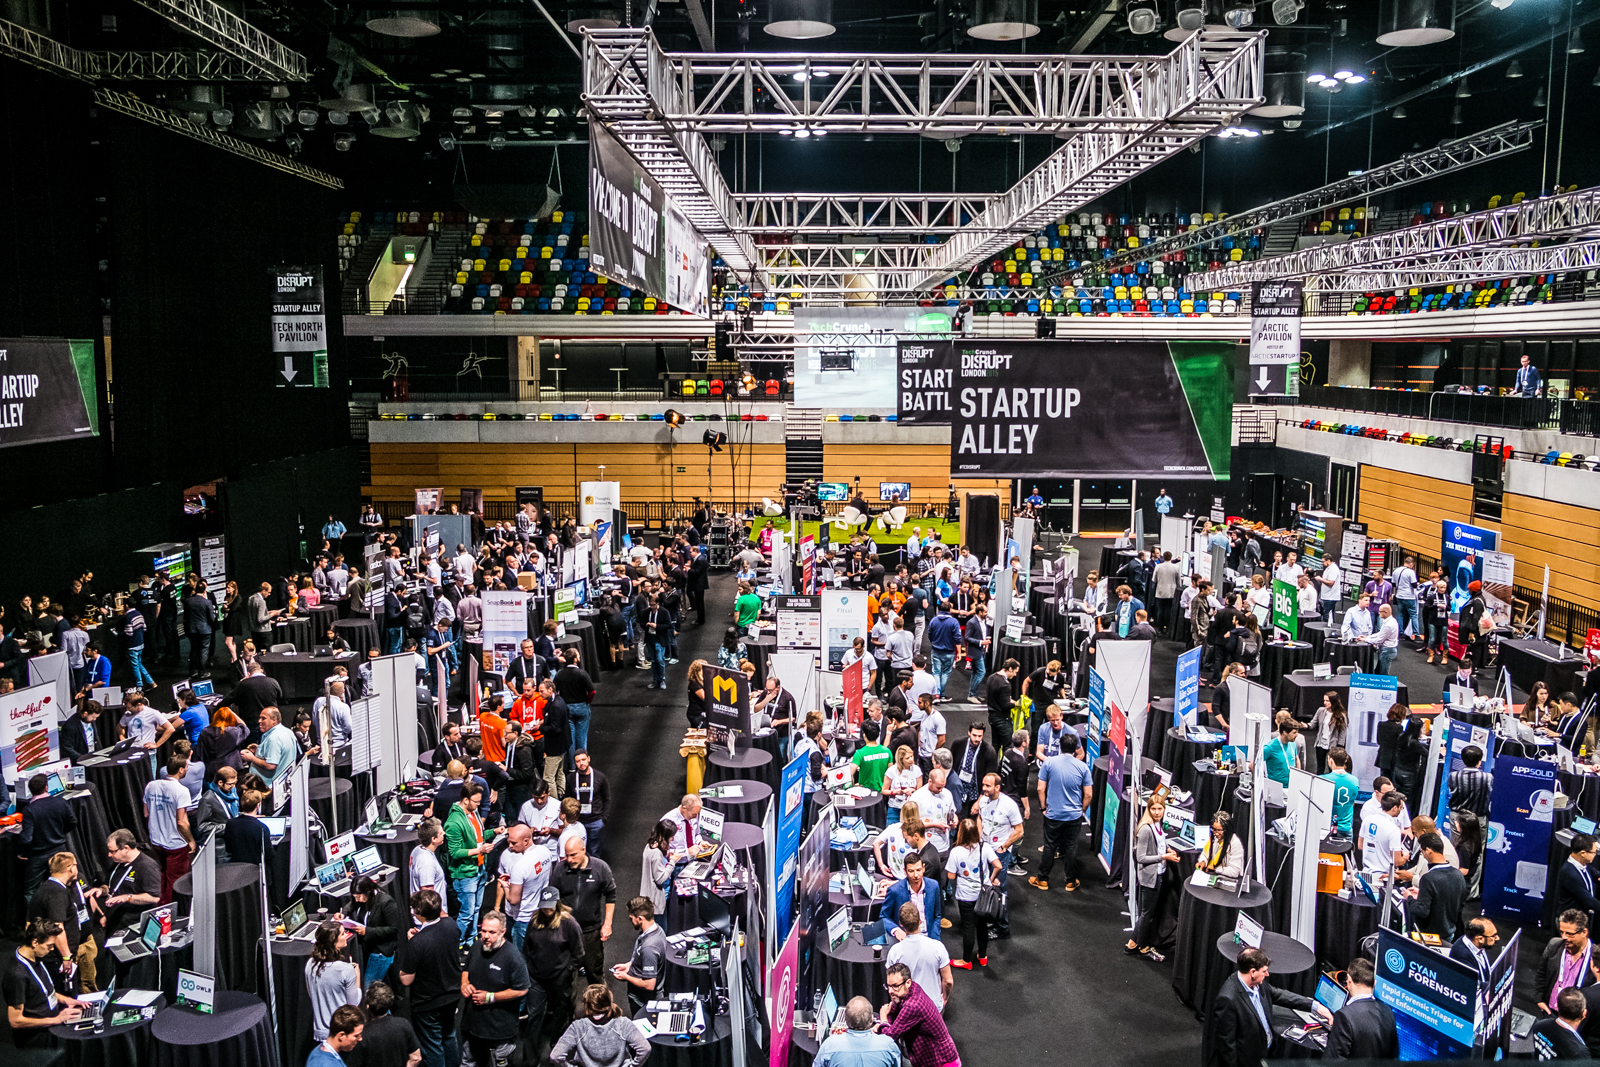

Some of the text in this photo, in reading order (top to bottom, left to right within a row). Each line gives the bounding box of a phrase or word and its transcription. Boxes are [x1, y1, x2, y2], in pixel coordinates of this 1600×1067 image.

[593, 168, 629, 233] WELCOME TO
[632, 191, 658, 258] DISRUPT
[277, 276, 313, 287] DISRUPT
[1260, 288, 1294, 298] DISRUPT
[273, 304, 321, 313] STARTUP ALLEY
[1253, 307, 1299, 316] STARTUP ALLEY
[273, 322, 323, 332] TECH NORTH
[1262, 323, 1288, 332] ARCTIC
[279, 332, 318, 342] PAVILION
[1258, 332, 1292, 342] PAVILION
[902, 349, 934, 359] DISRUPT
[961, 355, 1013, 369] DISRUPT
[2, 374, 39, 399] ARTUP
[902, 392, 953, 411] BATTL
[960, 387, 1081, 418] STARTUP
[958, 424, 1039, 454] ALLEY
[1445, 541, 1454, 549] THE
[1455, 543, 1466, 553] NEXT
[1179, 675, 1197, 690] Students
[10, 700, 43, 721] thortful
[712, 702, 739, 715] MUZEUMS
[1512, 765, 1554, 778] APPSOLID
[700, 815, 721, 827] NEEO
[1505, 829, 1525, 838] Protect
[1503, 886, 1518, 894] Track
[1409, 960, 1437, 980] CYAN
[1408, 969, 1468, 1006] FORENSICS
[1381, 991, 1439, 1026] Law Enforcement
[1382, 982, 1464, 1029] Rapid Forensic Triage for
